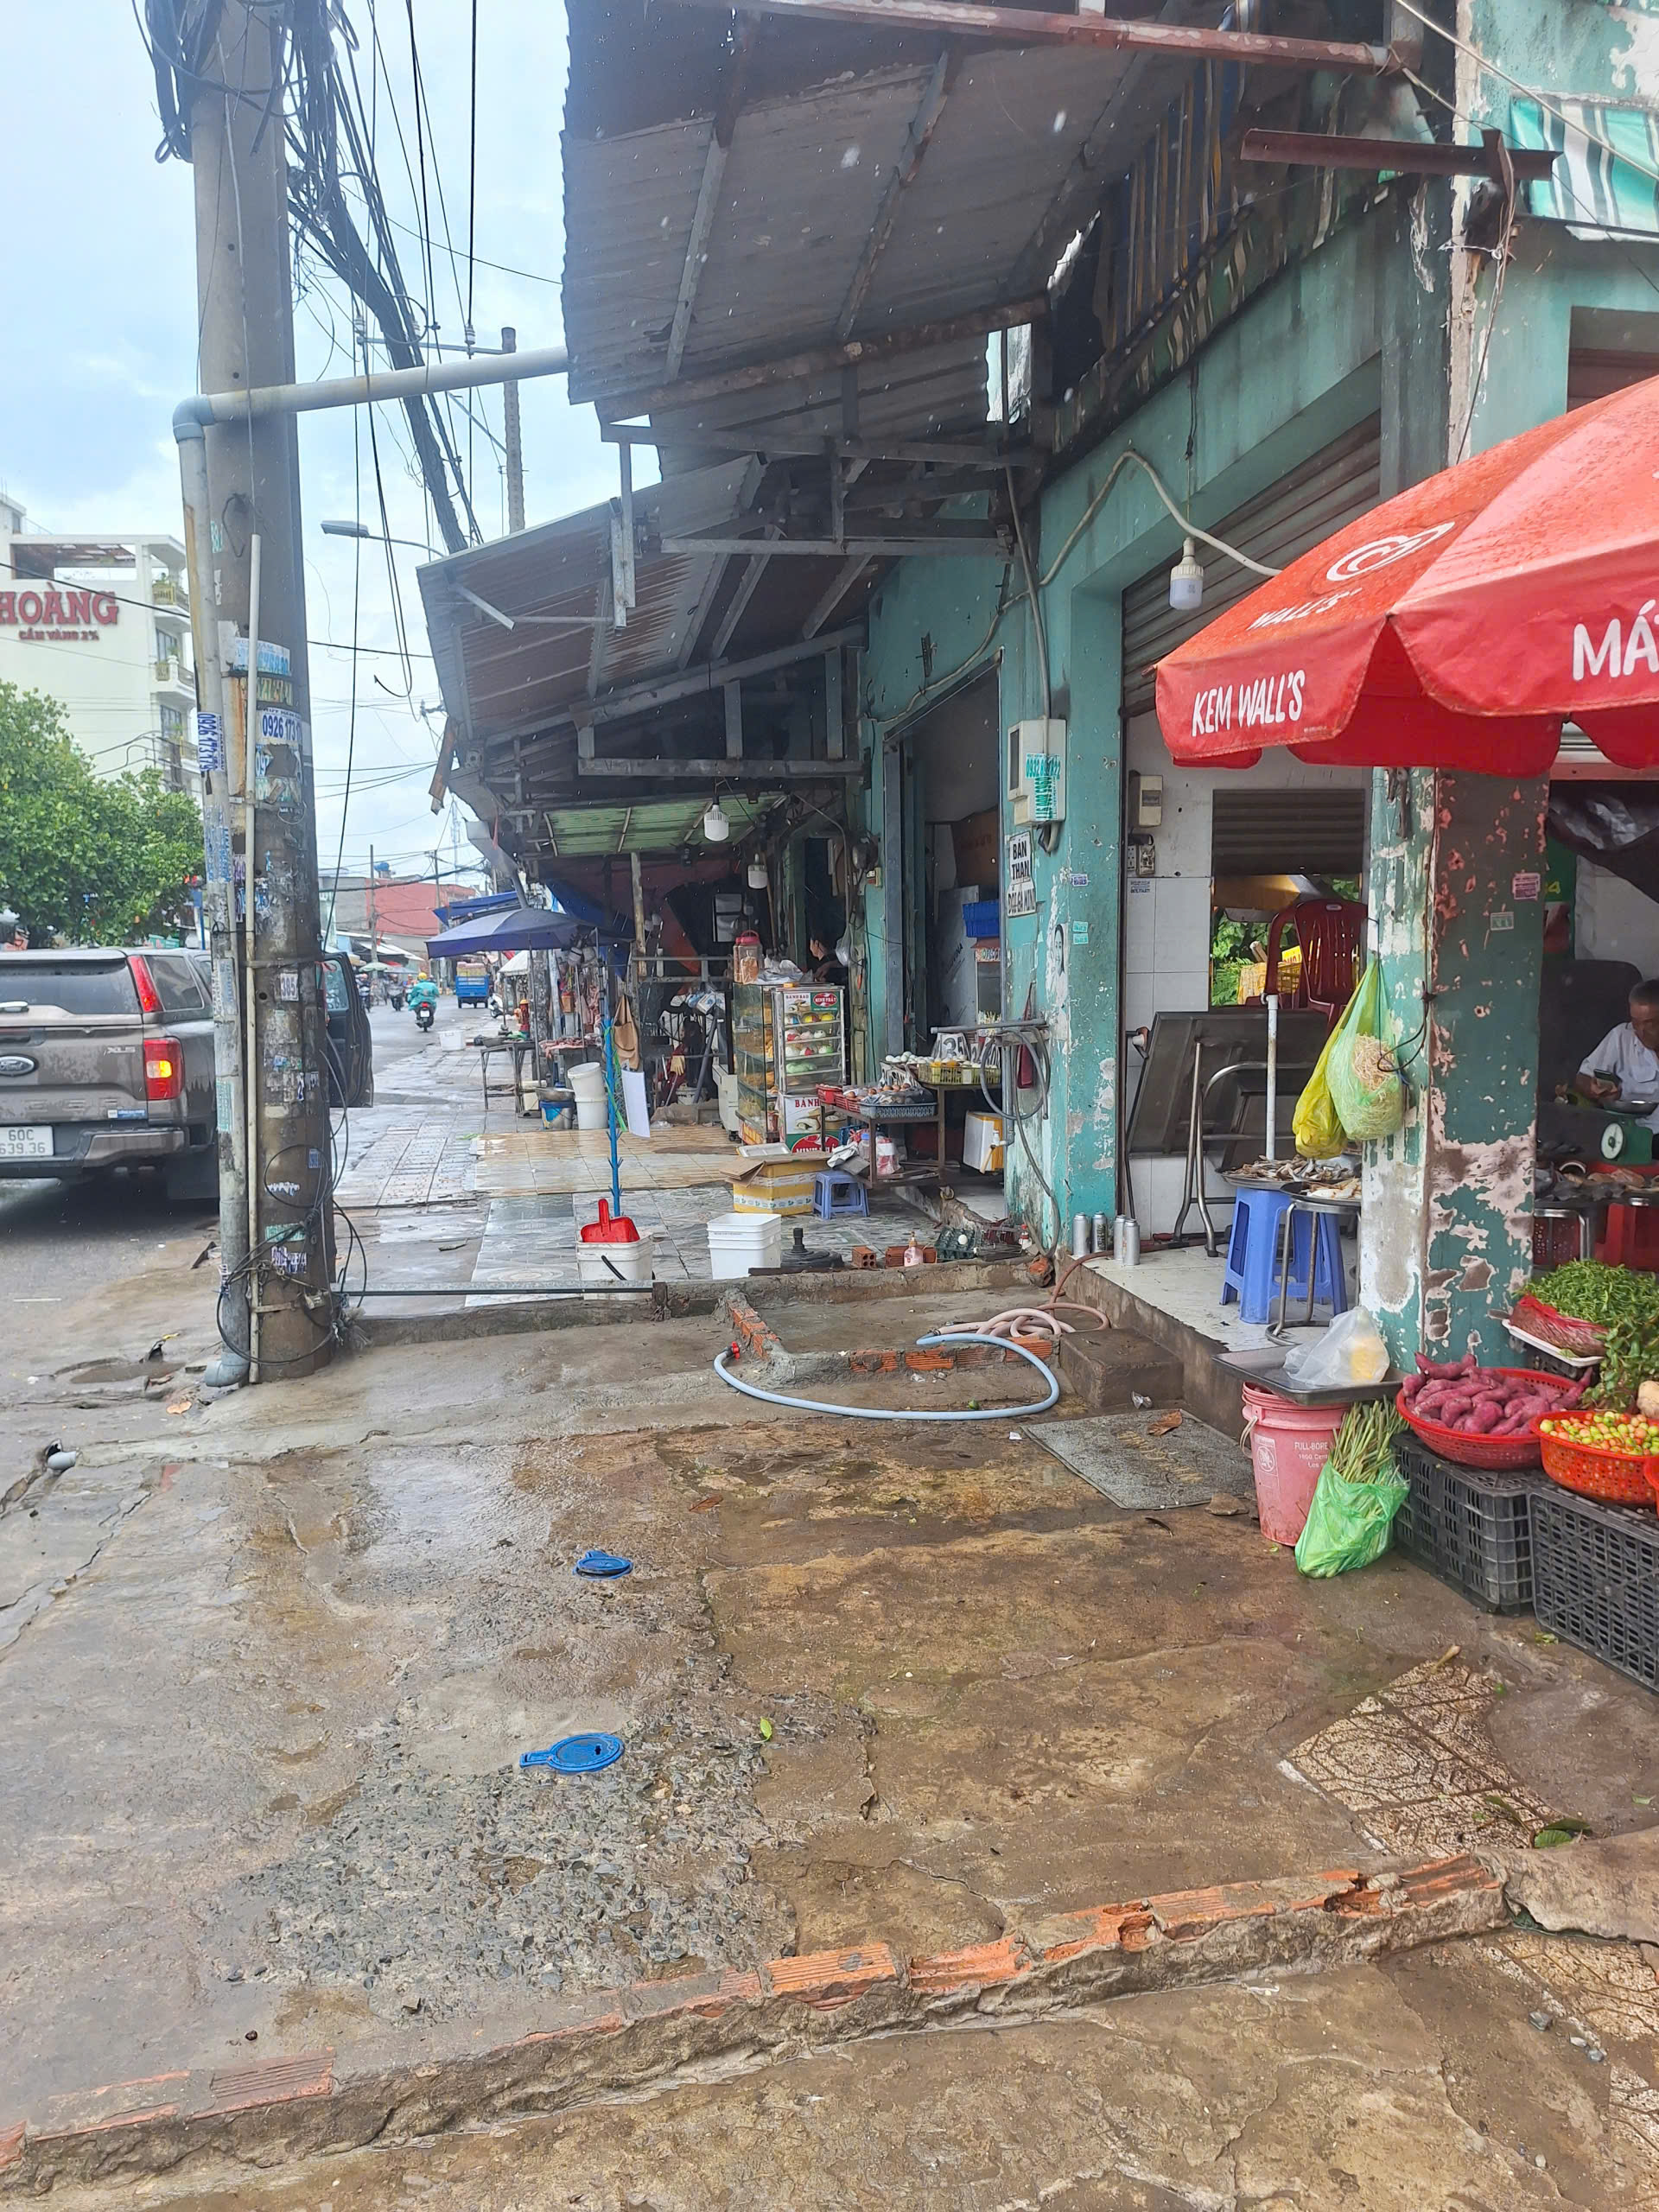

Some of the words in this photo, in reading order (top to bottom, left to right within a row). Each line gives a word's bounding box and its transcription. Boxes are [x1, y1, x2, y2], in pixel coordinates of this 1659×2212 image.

[0, 582, 119, 625] HOÀNG
[1573, 599, 1659, 681] MÁ
[1192, 690, 1231, 737] KEM
[1237, 670, 1306, 728] WALL'S
[197, 713, 218, 735] 0926
[263, 715, 283, 739] 0926
[1013, 839, 1027, 860] BÁN
[8, 1128, 34, 1141] 60C
[0, 1141, 46, 1154] 639.36
